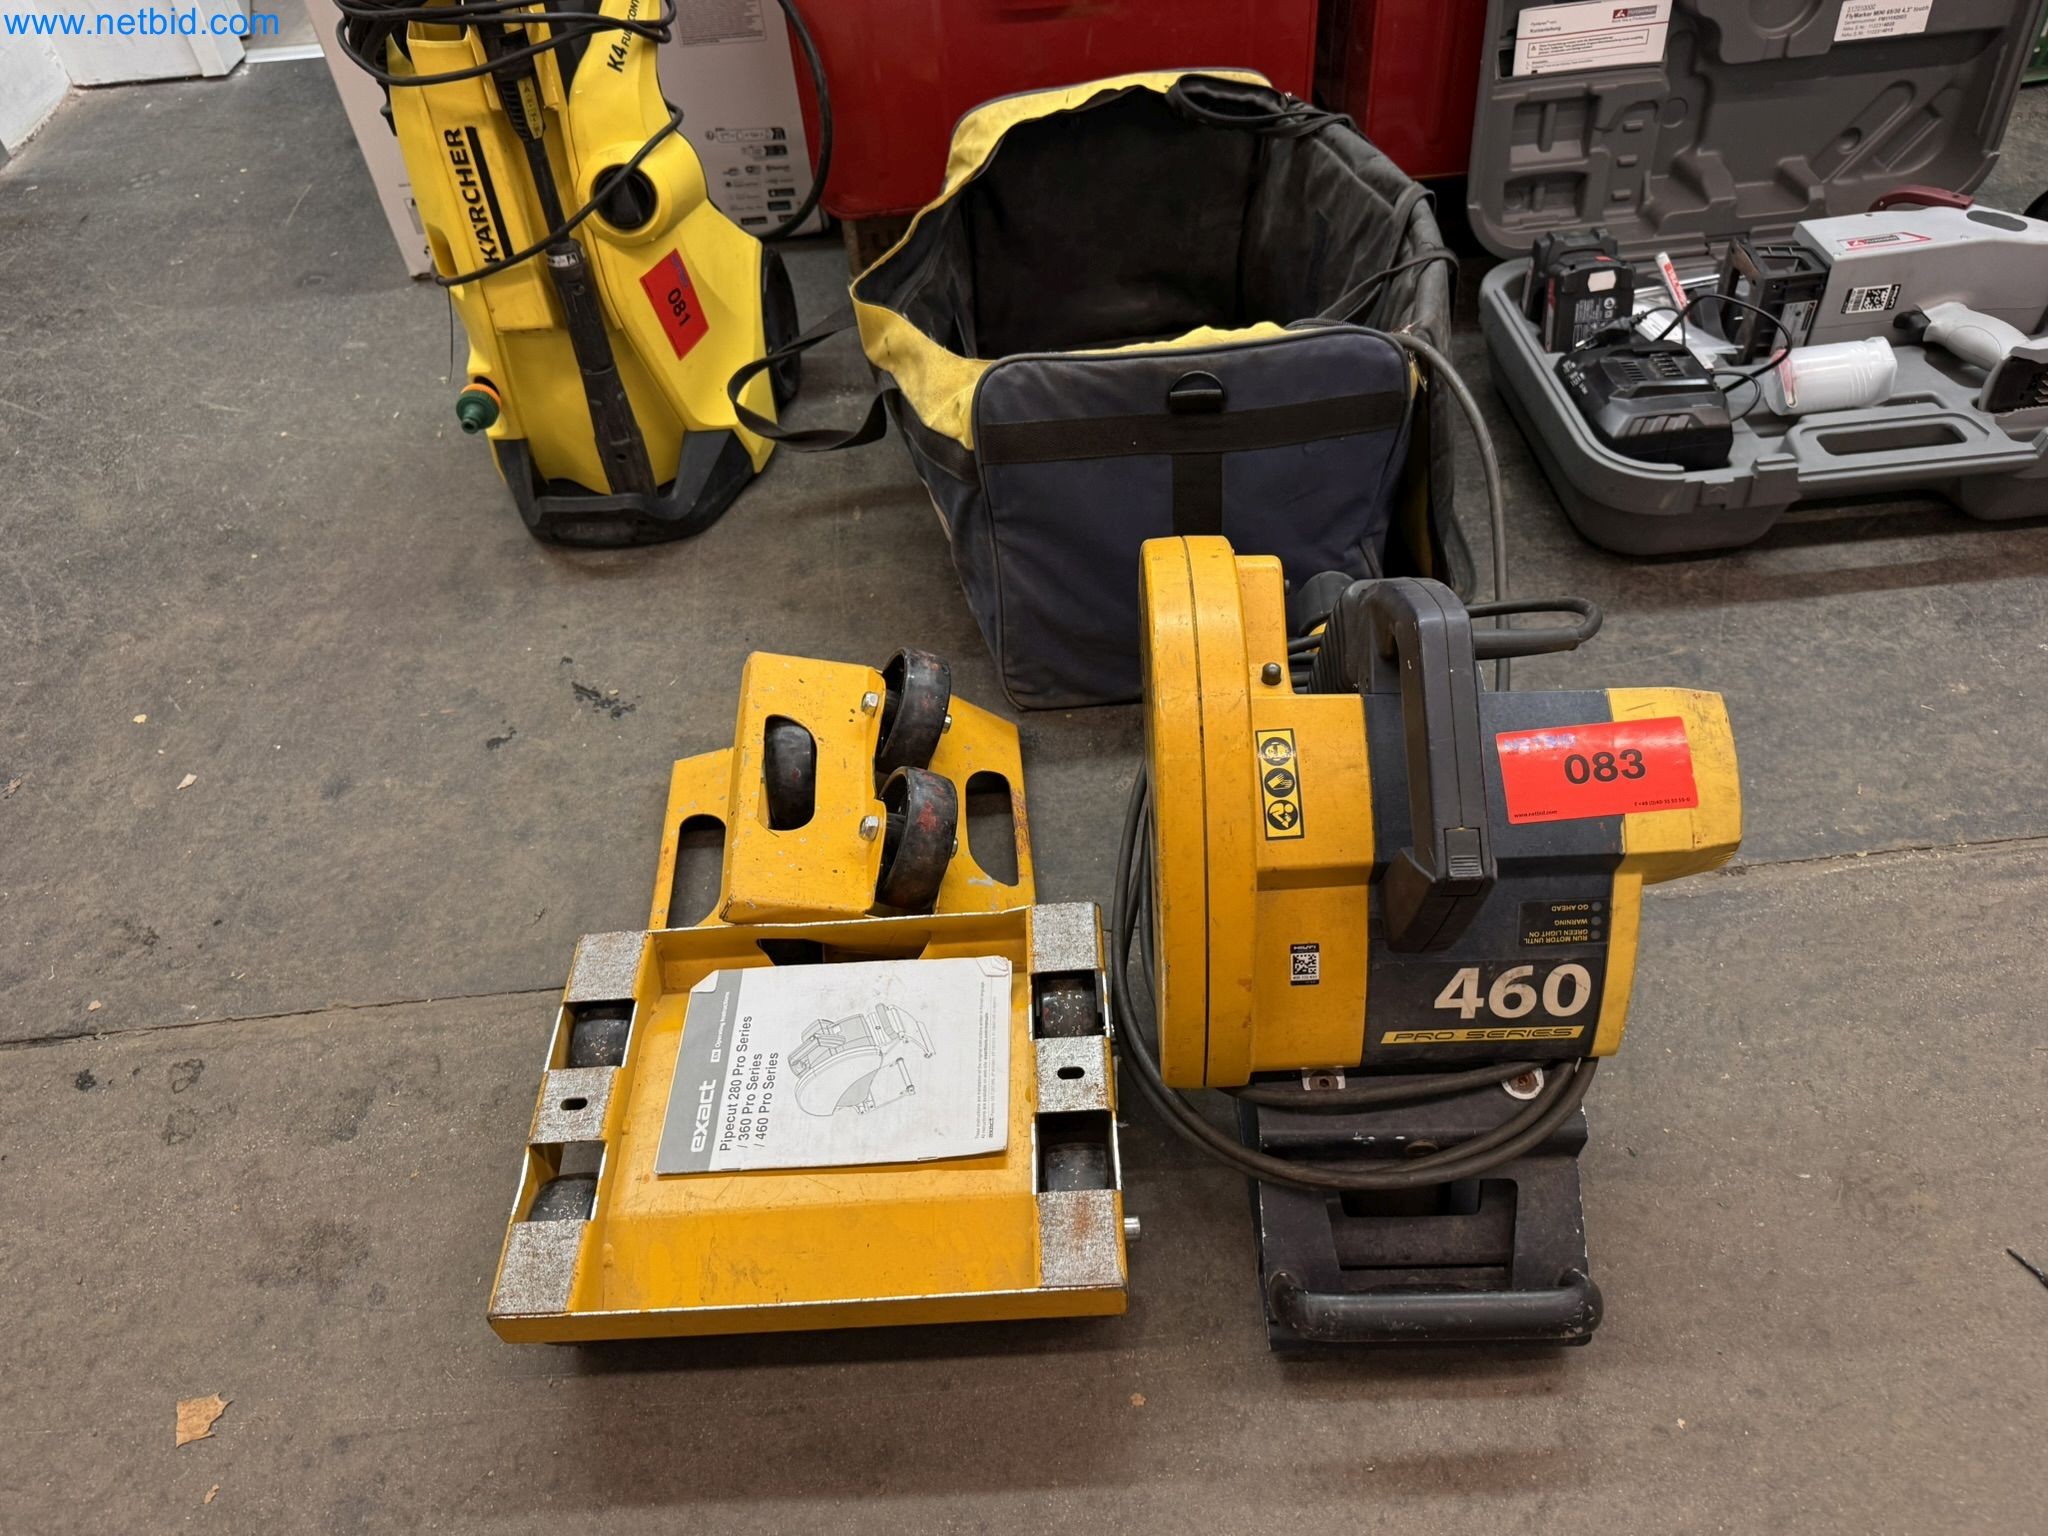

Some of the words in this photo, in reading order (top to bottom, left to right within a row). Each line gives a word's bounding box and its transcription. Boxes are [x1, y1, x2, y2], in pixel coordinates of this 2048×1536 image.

[607, 44, 627, 72] K4
[621, 30, 633, 47] FUL
[444, 128, 500, 263] KÄRCHER
[667, 288, 691, 327] 081
[1564, 749, 1646, 785] 083
[1551, 904, 1577, 912] AHEAD
[1554, 918, 1588, 926] WARNING
[1523, 937, 1544, 945] UNTIL
[1434, 963, 1592, 1019] 460
[736, 1016, 753, 1052] Series
[1394, 1031, 1454, 1042] PRO
[1465, 1028, 1573, 1040] SERIES
[732, 1055, 746, 1076] Pro
[746, 1053, 763, 1090] Series
[763, 1052, 779, 1089] Series
[728, 1079, 743, 1100] 280
[742, 1093, 756, 1114] Pro
[759, 1092, 773, 1113] Pro
[691, 1079, 717, 1152] exact
[719, 1103, 738, 1151] Pipecut
[738, 1118, 752, 1140] 360
[755, 1117, 769, 1140] 460
